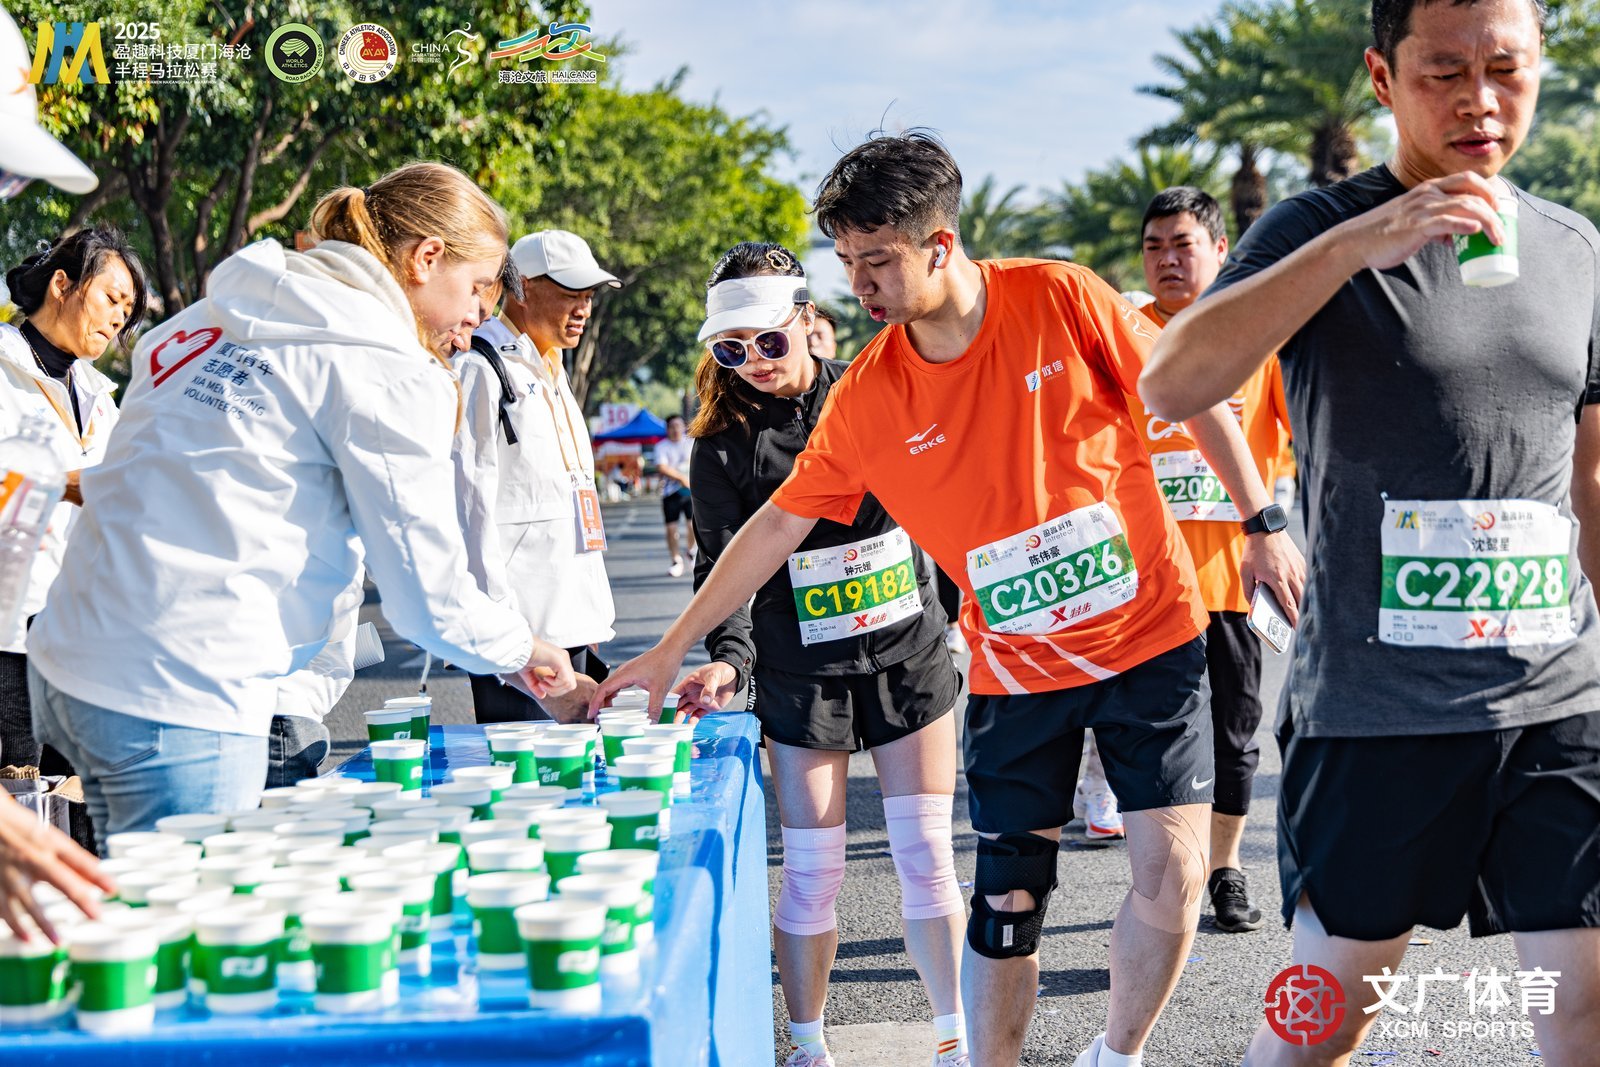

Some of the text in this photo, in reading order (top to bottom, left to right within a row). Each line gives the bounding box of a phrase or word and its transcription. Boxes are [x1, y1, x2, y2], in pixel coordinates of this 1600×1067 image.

[202, 358, 250, 386] 志愿者
[184, 386, 245, 420] VOLUNTEERS
[192, 376, 266, 416] XIA MEN YOUNG
[910, 433, 946, 456] ERKE
[1028, 544, 1062, 568] 陈伟豪
[804, 564, 912, 617] C19182
[990, 543, 1122, 617] C20326
[1395, 558, 1564, 607] C22928
